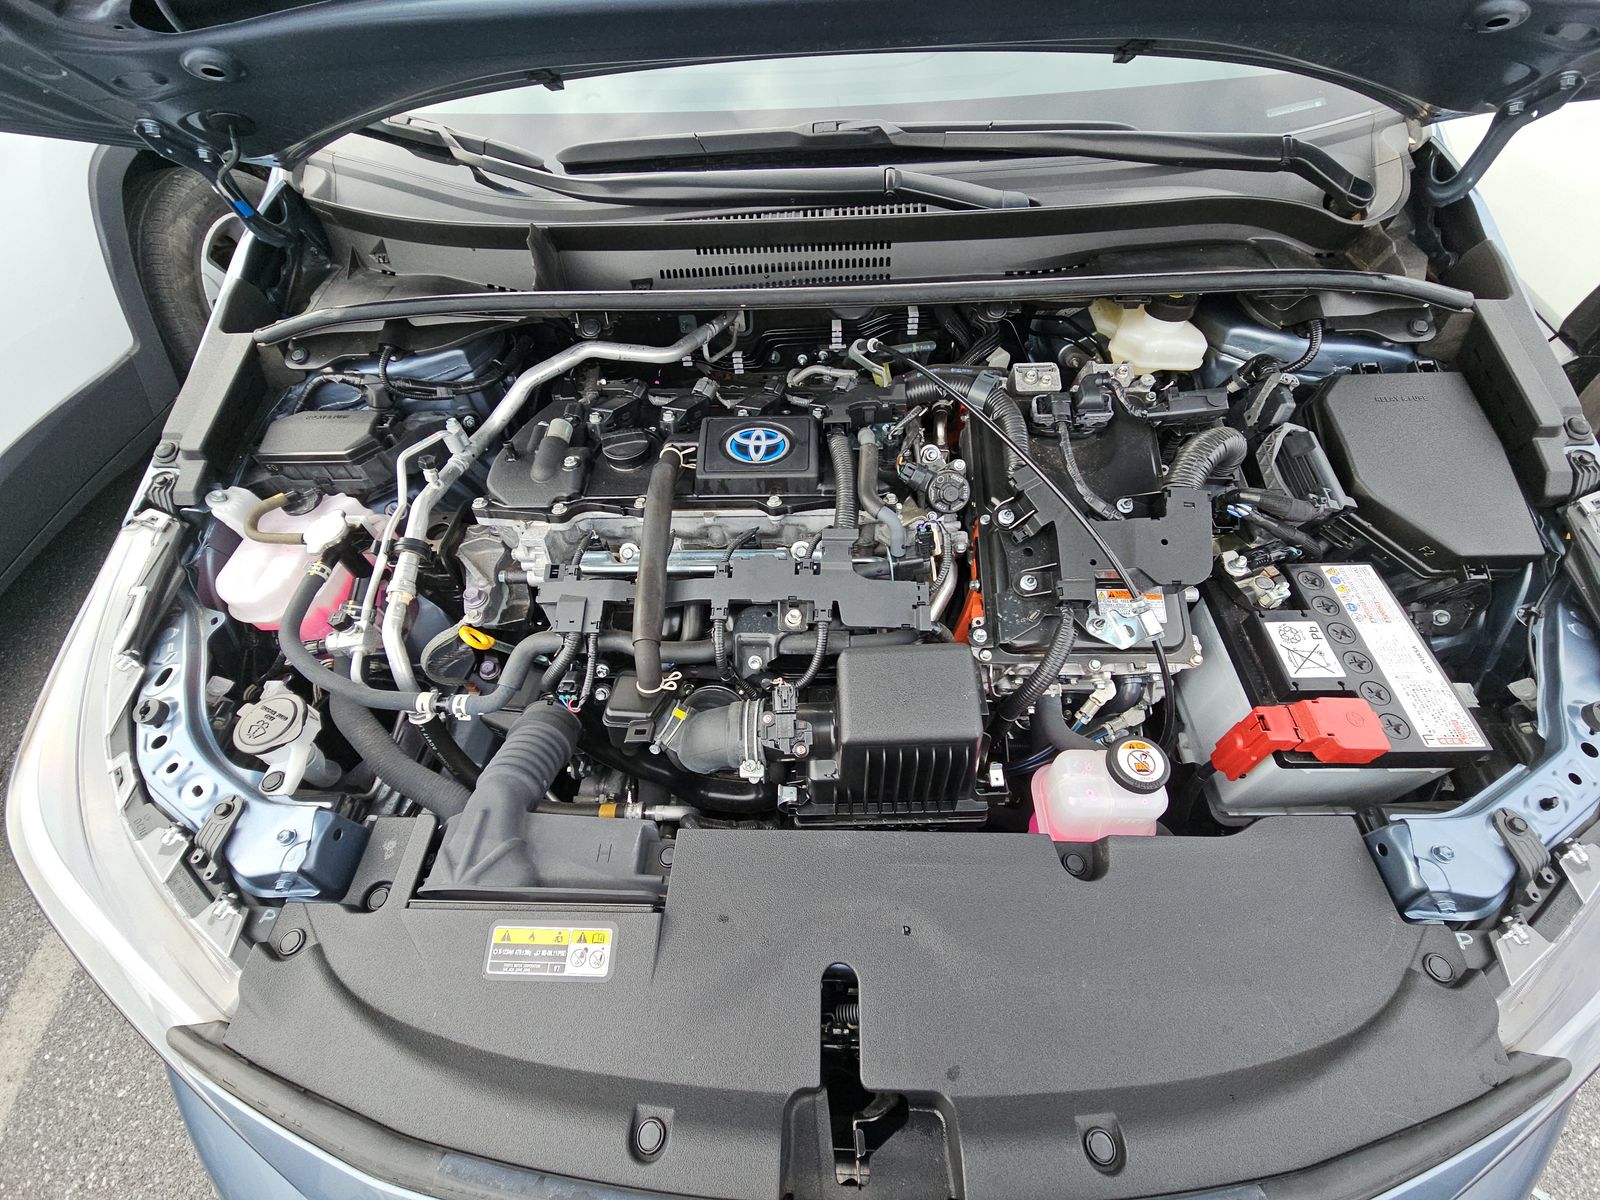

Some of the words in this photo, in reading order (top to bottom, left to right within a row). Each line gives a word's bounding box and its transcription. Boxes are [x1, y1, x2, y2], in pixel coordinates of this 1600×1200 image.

[1418, 545, 1436, 558] F2
[1309, 626, 1323, 640] Pb
[258, 908, 276, 924] P
[1454, 932, 1474, 951] P
